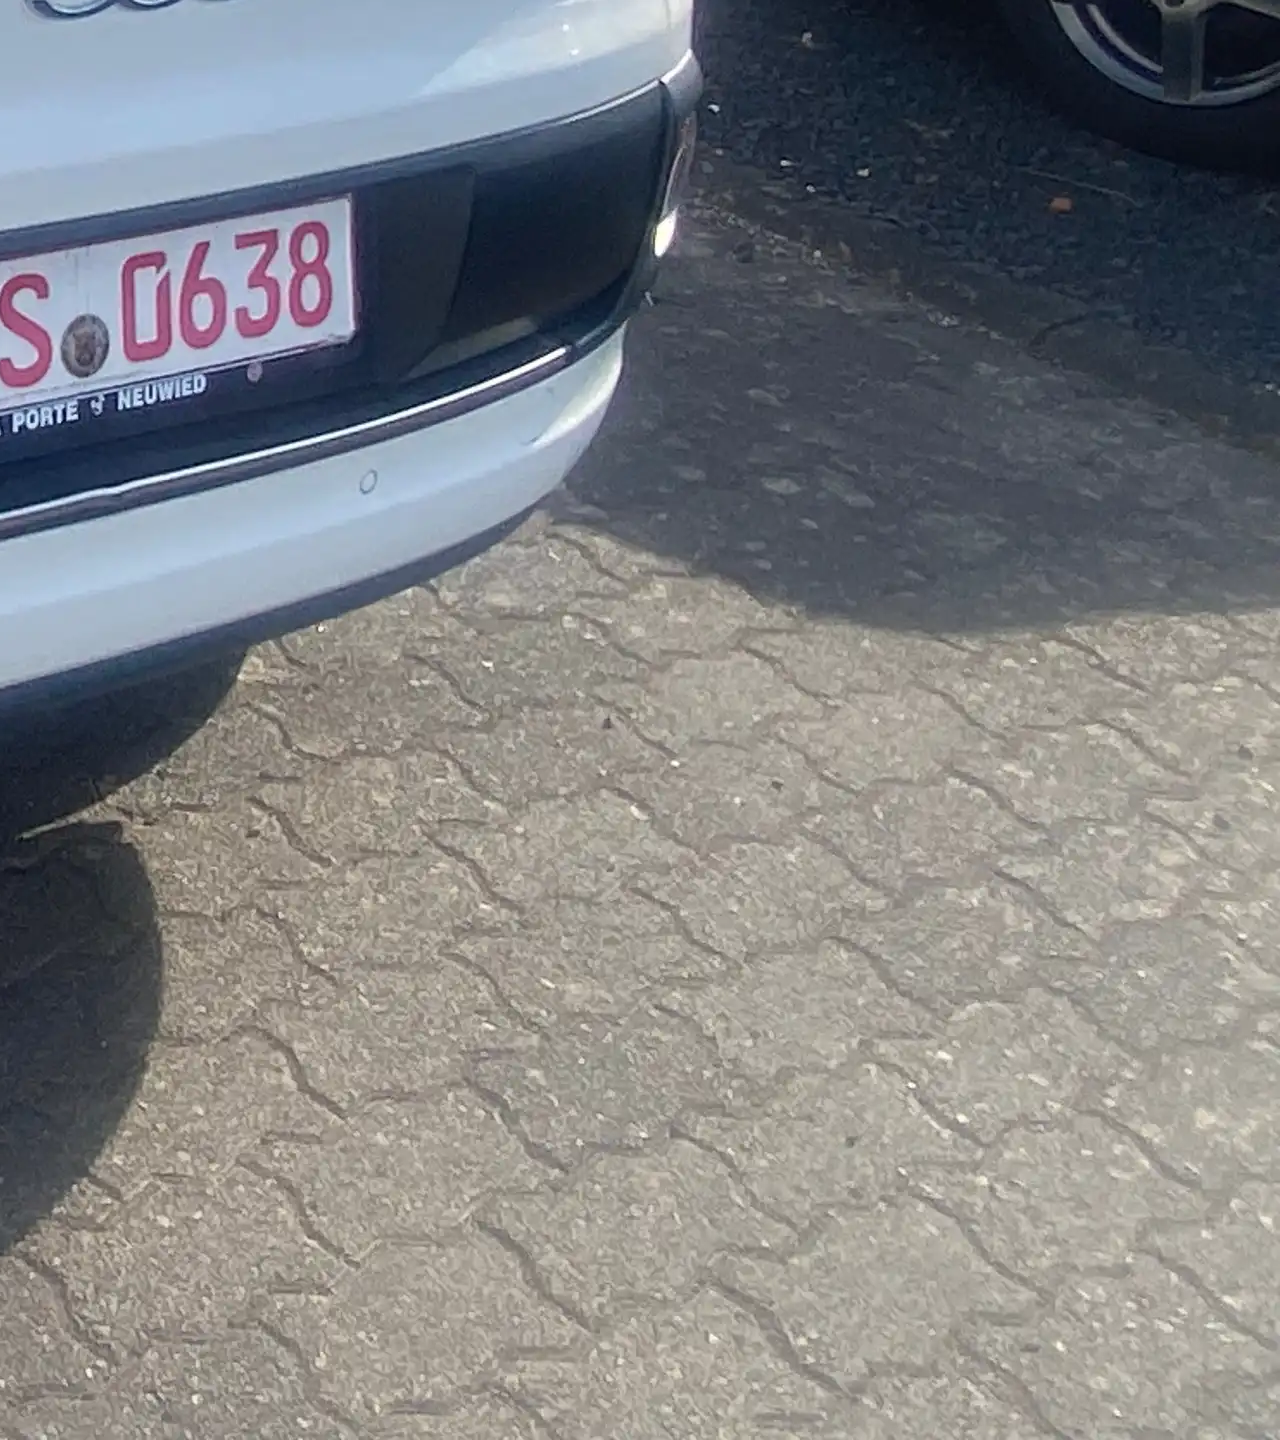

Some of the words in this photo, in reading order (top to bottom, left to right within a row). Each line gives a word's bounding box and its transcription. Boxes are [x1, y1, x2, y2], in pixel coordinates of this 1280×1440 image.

[121, 220, 333, 363] 0638
[11, 400, 80, 434] PORTE
[117, 373, 208, 411] NEUWIED
